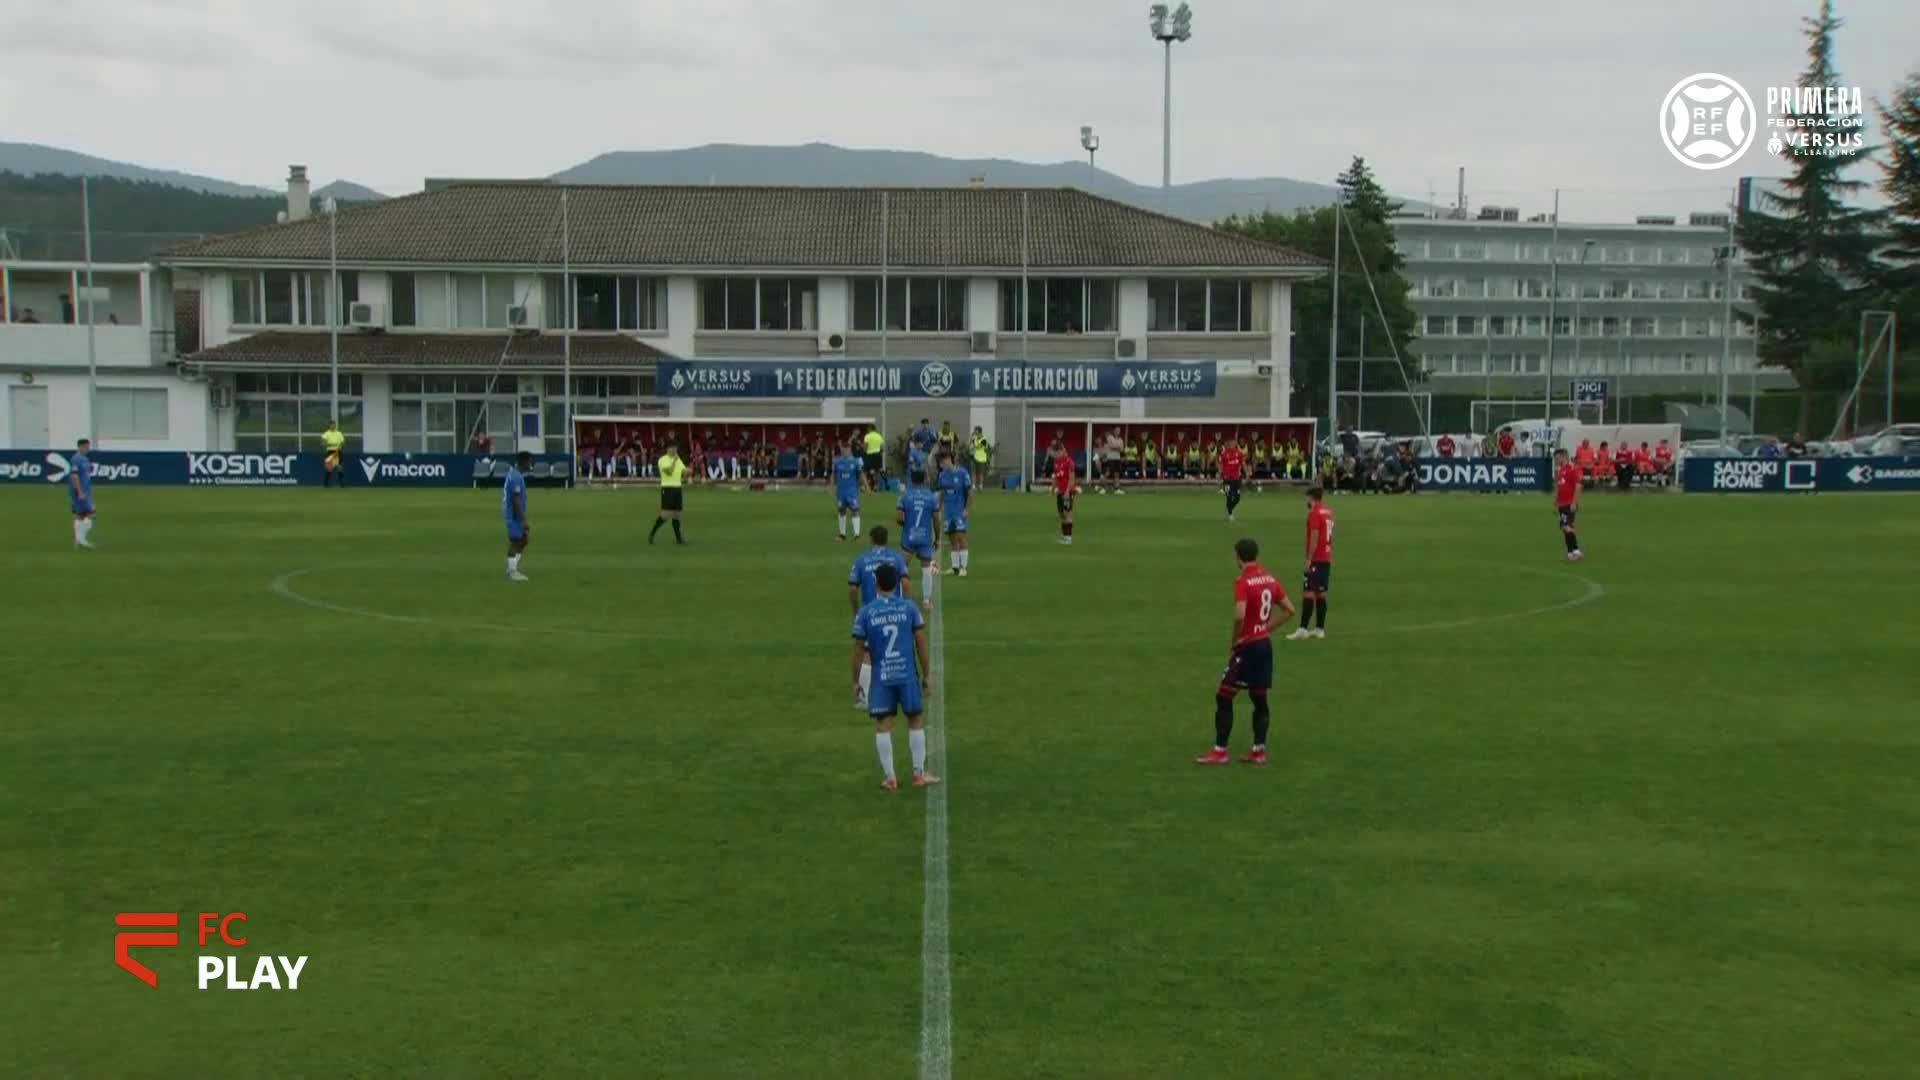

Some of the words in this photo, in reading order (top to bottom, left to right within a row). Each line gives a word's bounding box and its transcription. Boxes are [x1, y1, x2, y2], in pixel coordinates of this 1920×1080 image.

[687, 369, 751, 383] VERSUS
[796, 366, 901, 391] FEDERACIÓN
[993, 365, 1098, 391] FEDERACIÓN
[1137, 369, 1202, 383] VERSUS
[89, 463, 140, 480] Jaylo
[381, 463, 446, 477] macron
[1419, 464, 1508, 484] JONAR
[1713, 461, 1778, 475] SALTOKI
[1713, 475, 1763, 488] HOME
[914, 506, 924, 528] 7
[1260, 588, 1272, 621] 8
[882, 624, 901, 657] 2
